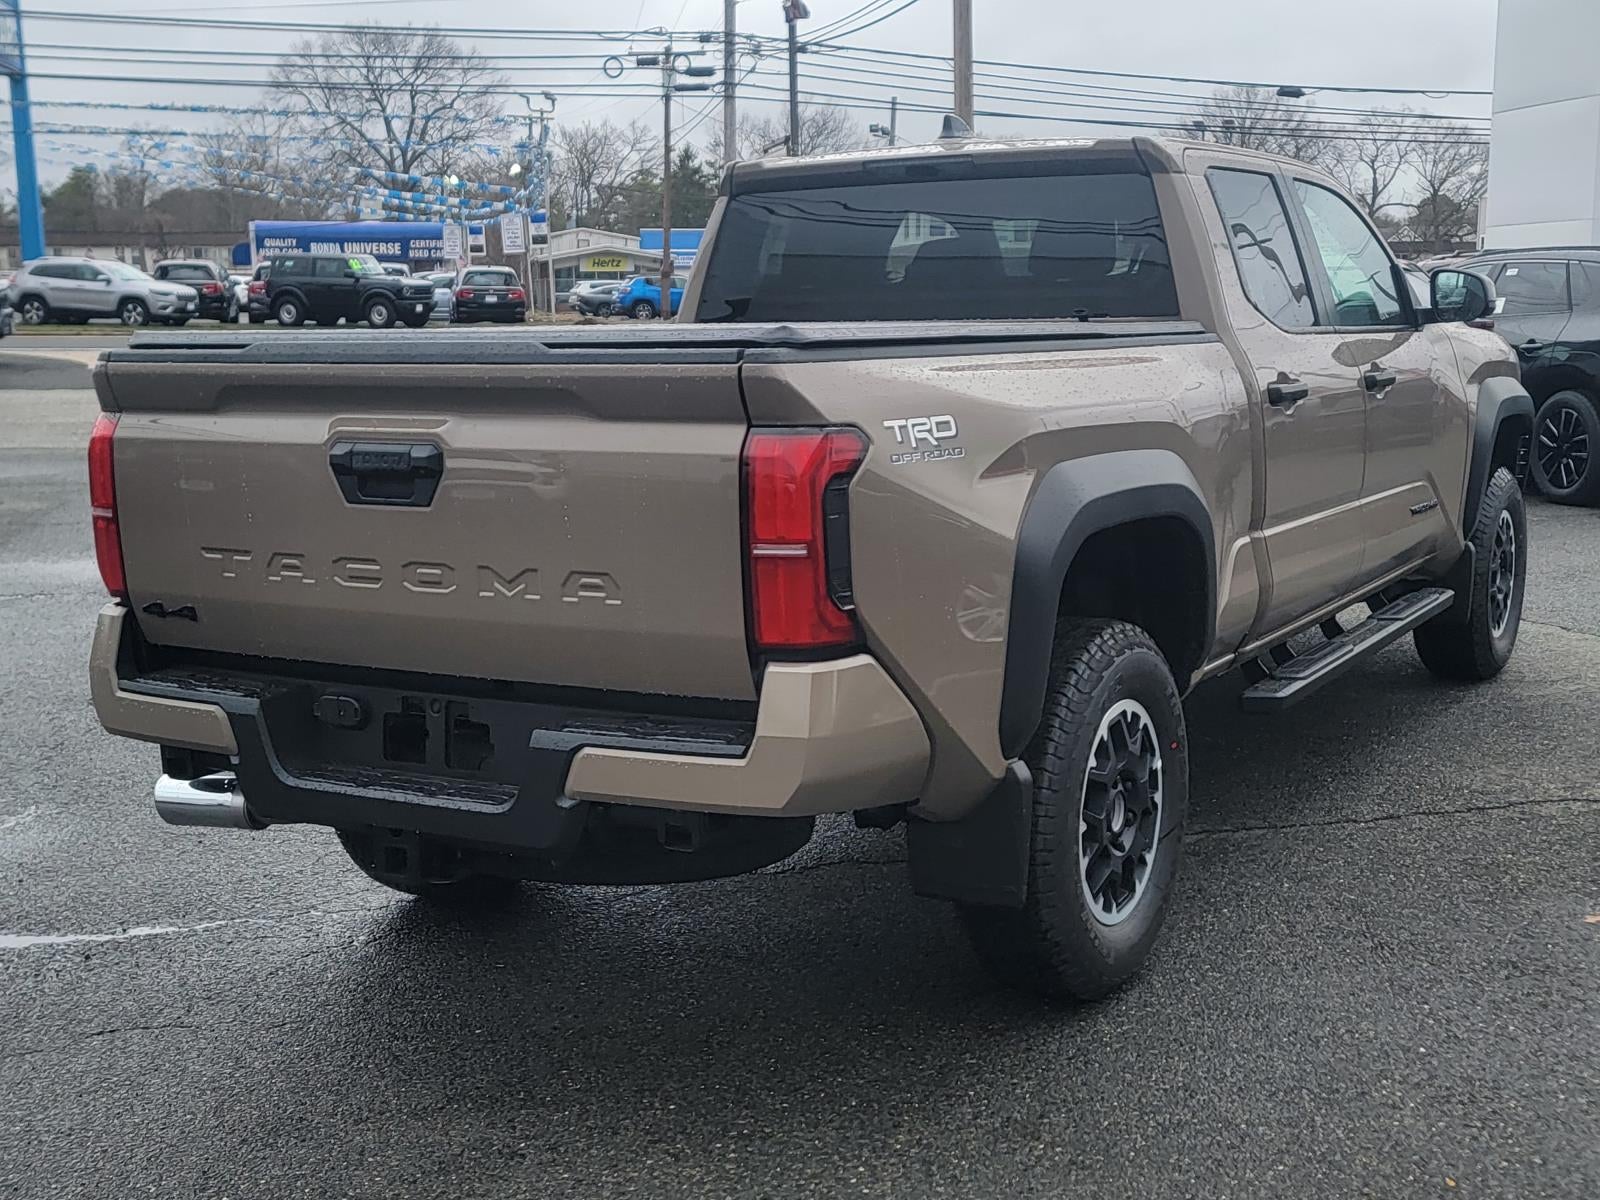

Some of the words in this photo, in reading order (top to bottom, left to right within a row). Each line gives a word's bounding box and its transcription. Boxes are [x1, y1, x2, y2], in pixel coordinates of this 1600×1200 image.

[264, 237, 297, 247] QUALITY
[410, 239, 444, 248] CERTIFIE
[344, 242, 402, 254] UNIVERSE
[409, 249, 430, 258] USED
[592, 258, 622, 268] Hertz
[883, 414, 958, 448] TRD
[890, 451, 922, 465] OFF
[924, 447, 966, 462] ROAD
[200, 546, 623, 605] TACOMA
